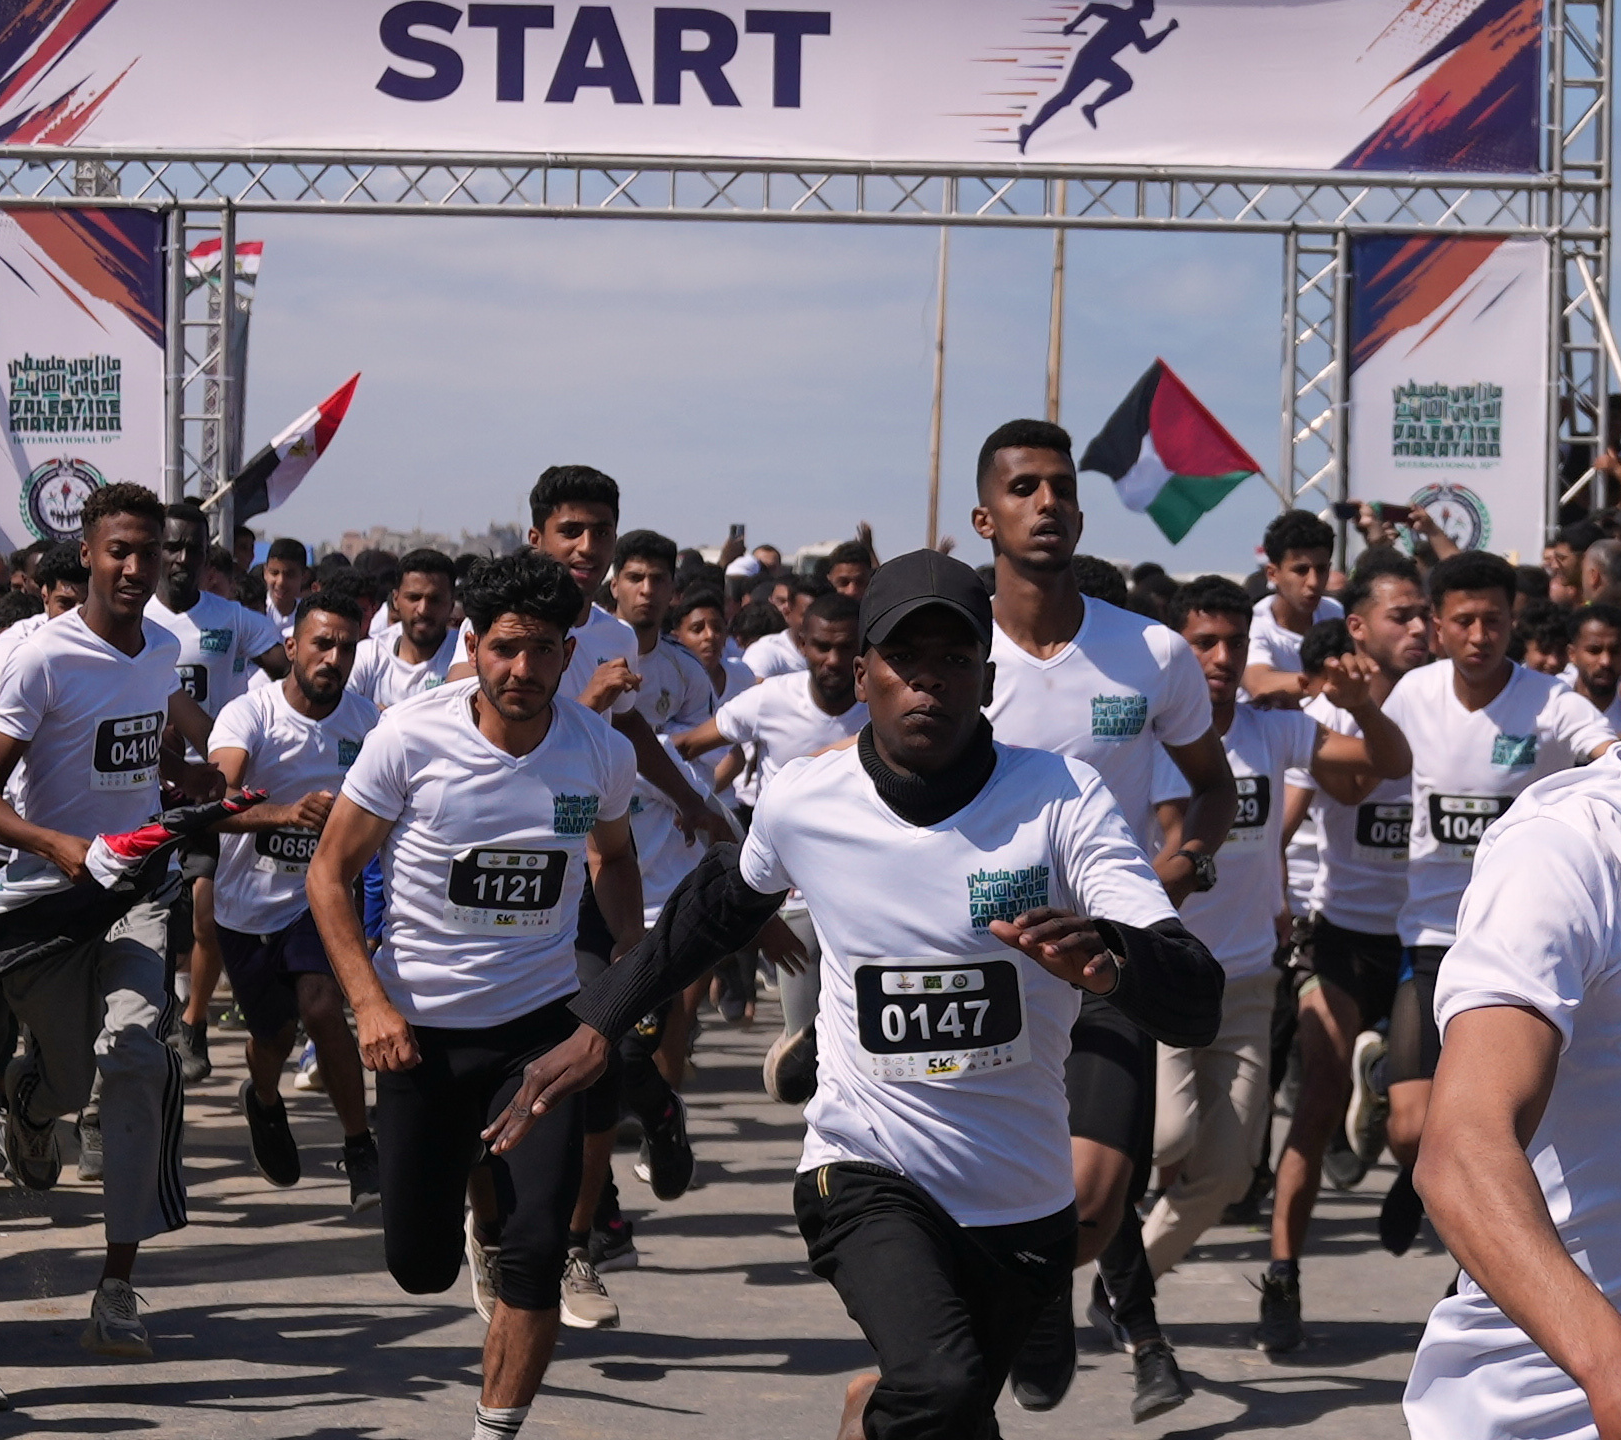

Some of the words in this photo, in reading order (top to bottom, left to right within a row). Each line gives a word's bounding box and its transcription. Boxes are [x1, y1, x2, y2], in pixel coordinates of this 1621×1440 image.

[376, 0, 832, 110] START
[9, 399, 121, 416] PALESTINE
[10, 416, 122, 433] MARATHON
[110, 736, 157, 766] 0410
[473, 874, 542, 903] 1121
[881, 999, 991, 1042] 0147
